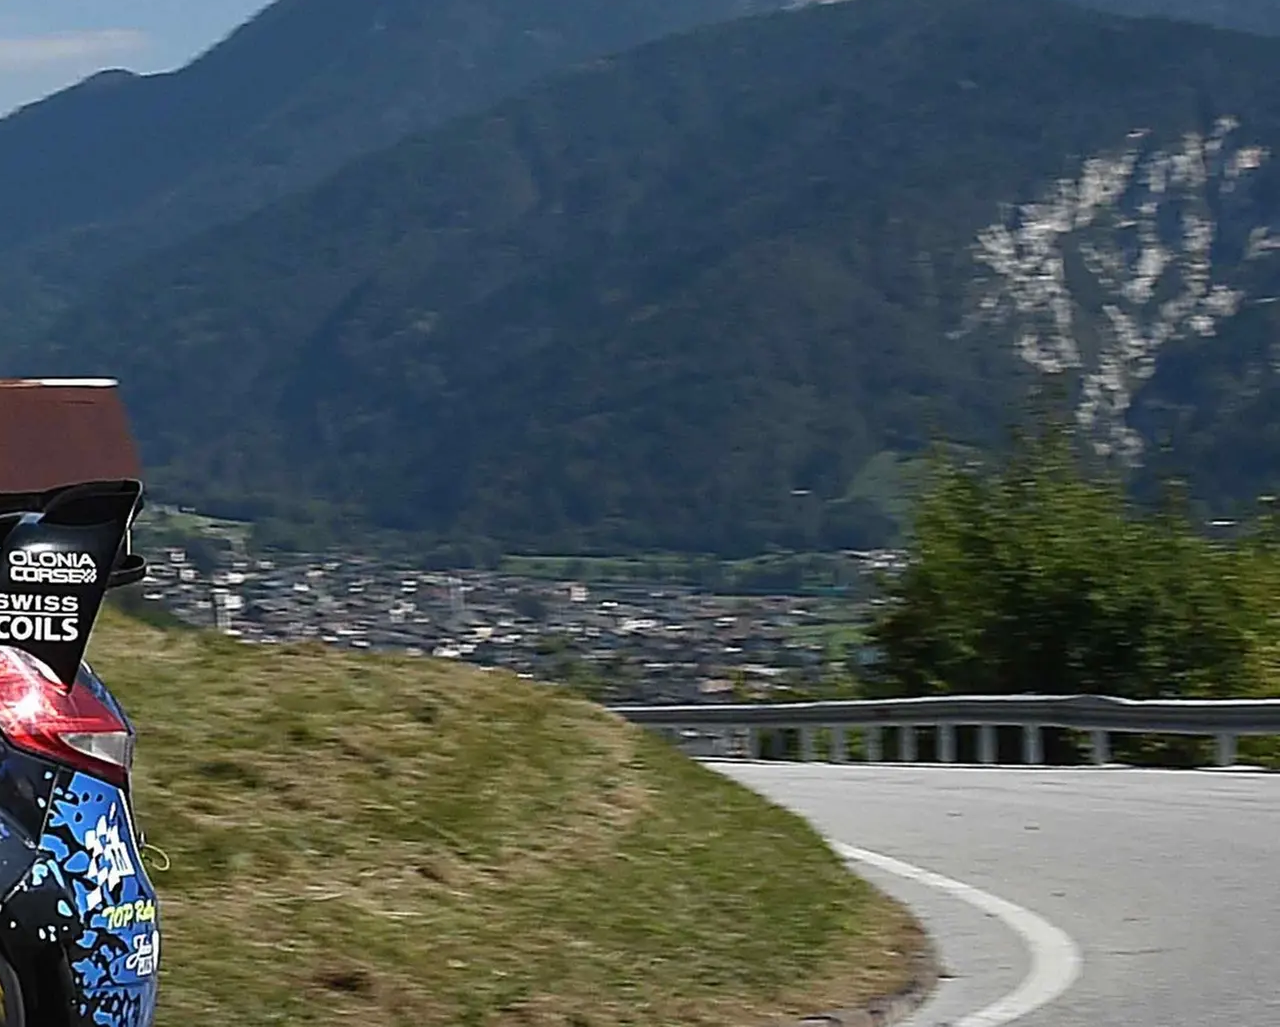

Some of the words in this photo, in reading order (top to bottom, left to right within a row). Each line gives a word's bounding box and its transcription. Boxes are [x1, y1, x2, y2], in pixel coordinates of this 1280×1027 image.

[8, 550, 96, 568] OLONIA
[10, 566, 83, 583] CORSE
[102, 904, 134, 930] TOP
